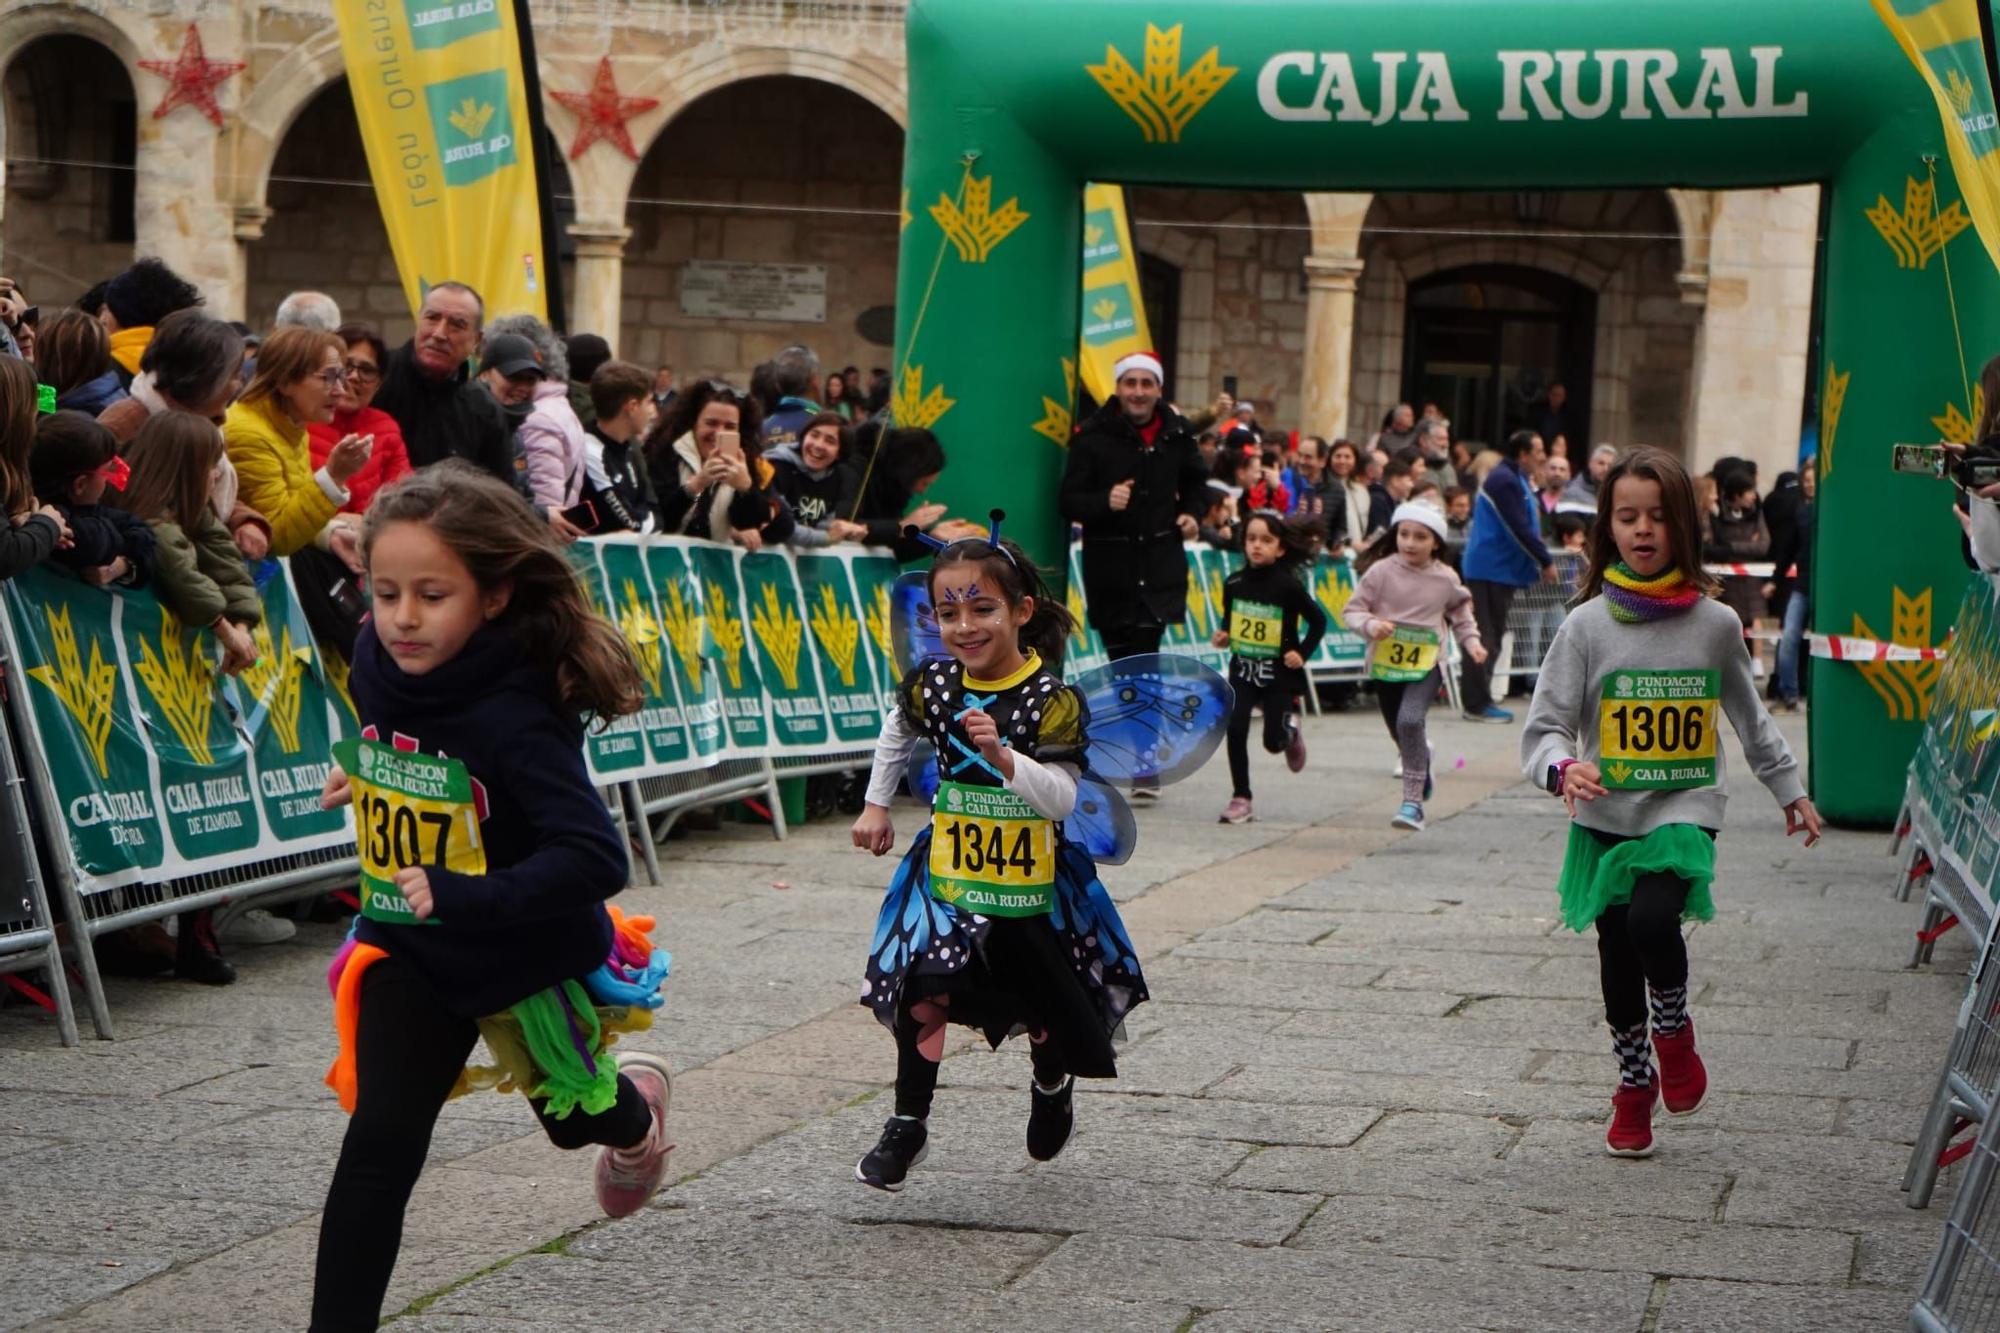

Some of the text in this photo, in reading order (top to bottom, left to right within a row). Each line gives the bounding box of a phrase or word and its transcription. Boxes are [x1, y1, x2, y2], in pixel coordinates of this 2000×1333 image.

[1256, 46, 1808, 126] CAJA RURAL
[1241, 618, 1266, 642] 28
[1390, 643, 1420, 668] 34
[1636, 676, 1707, 688] FUNDACION
[1637, 687, 1707, 698] CAJA RURAL
[1612, 705, 1704, 752] 1306
[261, 768, 292, 798] CAJA
[375, 768, 403, 789] CAJA
[1634, 766, 1710, 781] CAJA RURAL
[166, 775, 250, 814] CAJA RURAL
[965, 790, 1025, 806] FUNDACIO
[108, 791, 154, 823] URAL
[279, 796, 325, 819] DE ZAMO
[966, 803, 1036, 818] CAJA RURAL
[187, 810, 243, 836] DE ZAMORA
[361, 791, 452, 868] 1307
[946, 821, 1036, 877] 1344
[372, 892, 415, 913] CAJA
[965, 890, 1047, 908] CAJA RURAL
